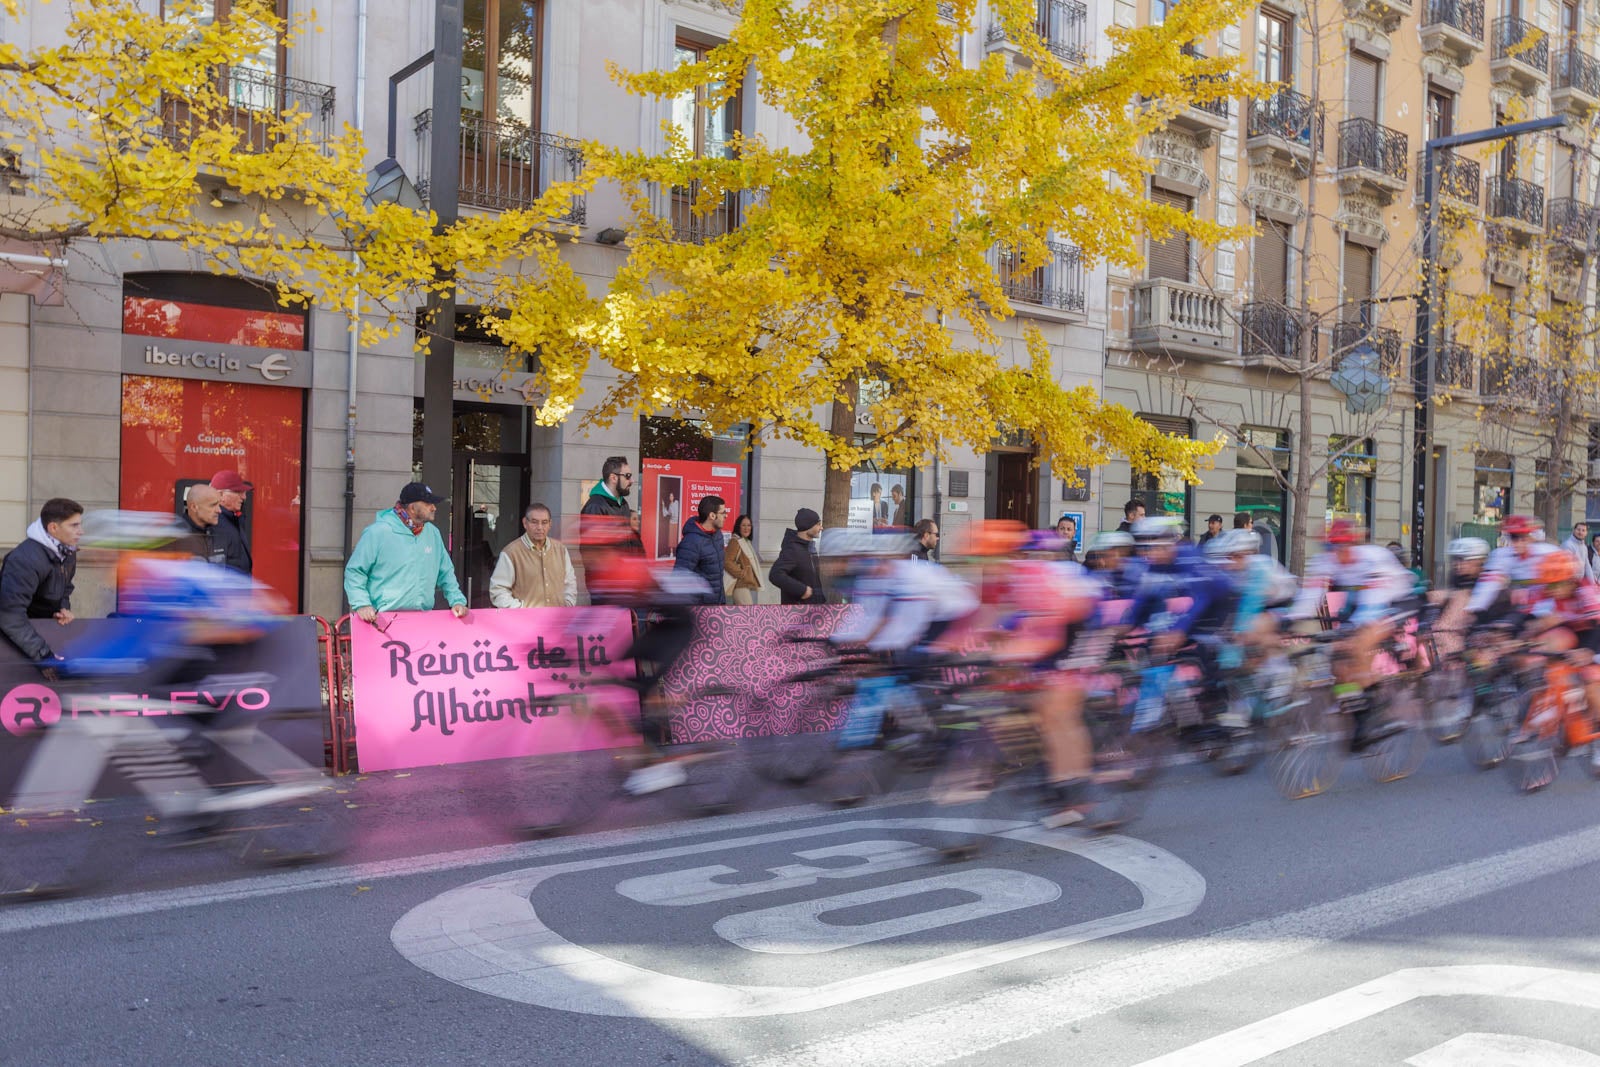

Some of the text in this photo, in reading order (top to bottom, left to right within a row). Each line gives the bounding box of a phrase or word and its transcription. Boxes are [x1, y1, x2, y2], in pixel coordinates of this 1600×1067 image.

[452, 377, 506, 396] erCaja
[197, 433, 233, 445] Cajero
[527, 636, 572, 669] de
